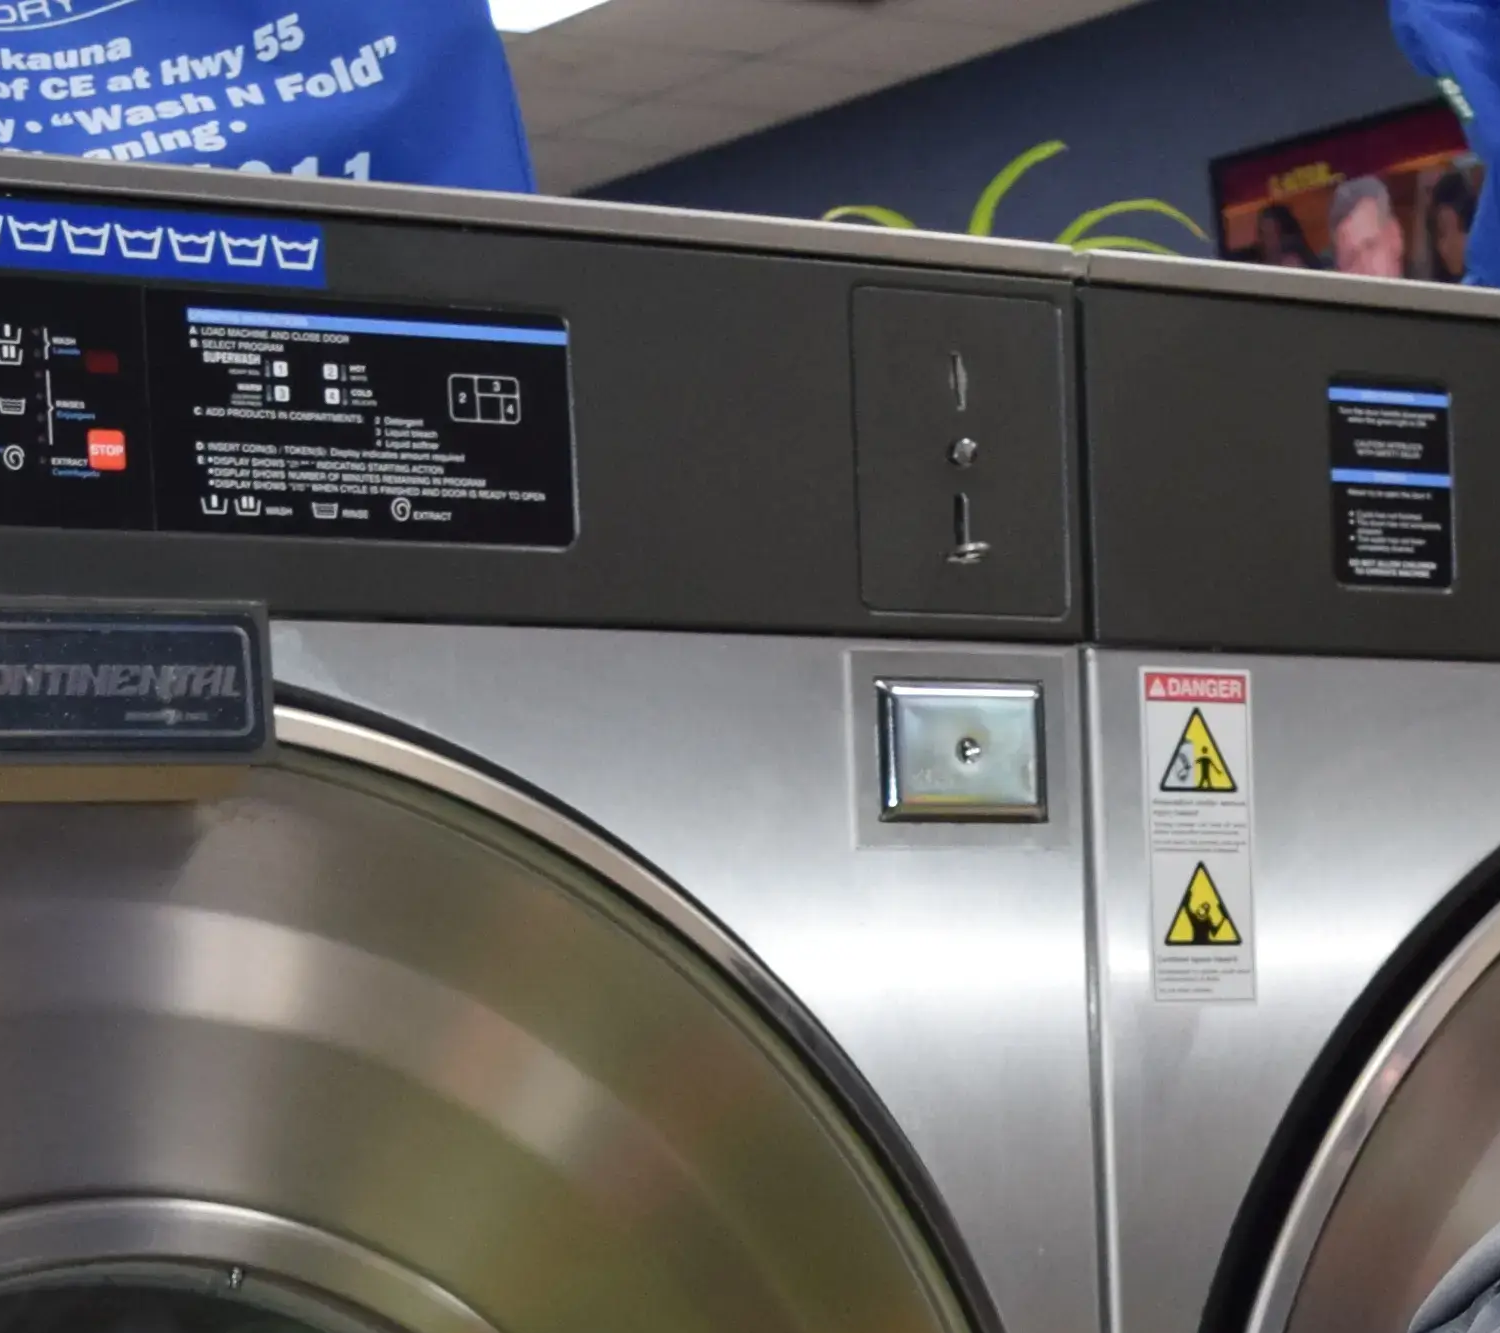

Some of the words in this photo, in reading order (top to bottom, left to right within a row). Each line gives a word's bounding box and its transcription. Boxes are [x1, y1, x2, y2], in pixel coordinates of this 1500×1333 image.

[39, 75, 96, 100] CE
[107, 67, 151, 93] at
[160, 45, 244, 86] Hwy
[253, 12, 305, 62] 55
[226, 83, 265, 108] N
[200, 328, 225, 337] LOAD
[271, 331, 289, 340] AND
[292, 332, 320, 342] CLOSE
[323, 334, 350, 343] DOOR
[203, 340, 236, 349] SELECT
[239, 341, 284, 352] PROGRAM
[203, 352, 261, 364] SUPERWASH
[493, 381, 500, 392] 3
[351, 389, 373, 398] COLD
[459, 392, 467, 403] 2
[56, 401, 85, 409] RINSES
[506, 404, 514, 414] 4
[206, 408, 225, 417] ADD
[227, 408, 276, 419] PRODUCTS
[90, 444, 123, 456] STOP
[51, 458, 88, 466] EXTRACT
[413, 511, 452, 521] EXTRACT
[1168, 678, 1242, 699] DANGER
